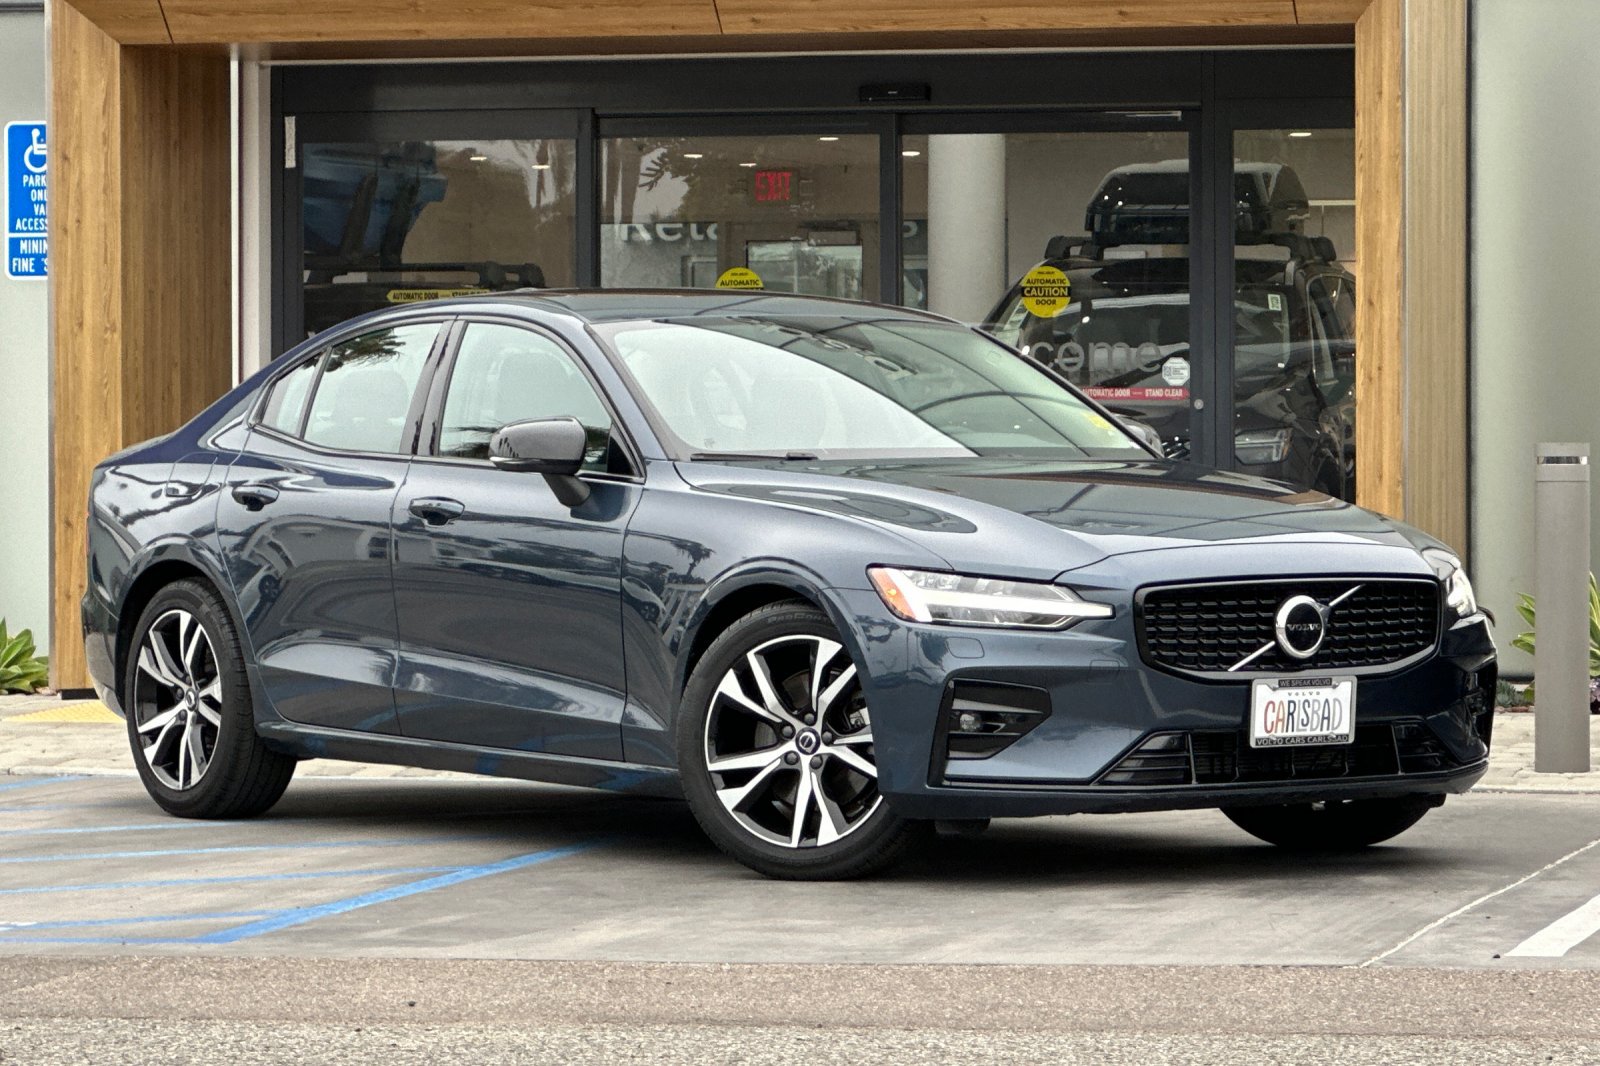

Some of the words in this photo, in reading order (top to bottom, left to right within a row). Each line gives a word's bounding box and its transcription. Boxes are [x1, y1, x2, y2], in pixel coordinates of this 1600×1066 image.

[755, 170, 792, 201] EXIT
[12, 257, 36, 272] FINE
[720, 279, 760, 287] AUTOMATIC
[392, 292, 424, 300] AUTOMATIC
[424, 292, 439, 300] DOOR
[1023, 287, 1069, 297] CAUTION
[1114, 388, 1131, 397] DOOR
[1145, 388, 1164, 397] STAND
[1164, 388, 1183, 397] CLEAR
[1286, 623, 1321, 631] VOLVO
[1291, 679, 1311, 687] SPEAK
[1263, 697, 1343, 734] CARLSBAD
[1257, 737, 1284, 746] VOLVO
[1285, 736, 1306, 744] CARS
